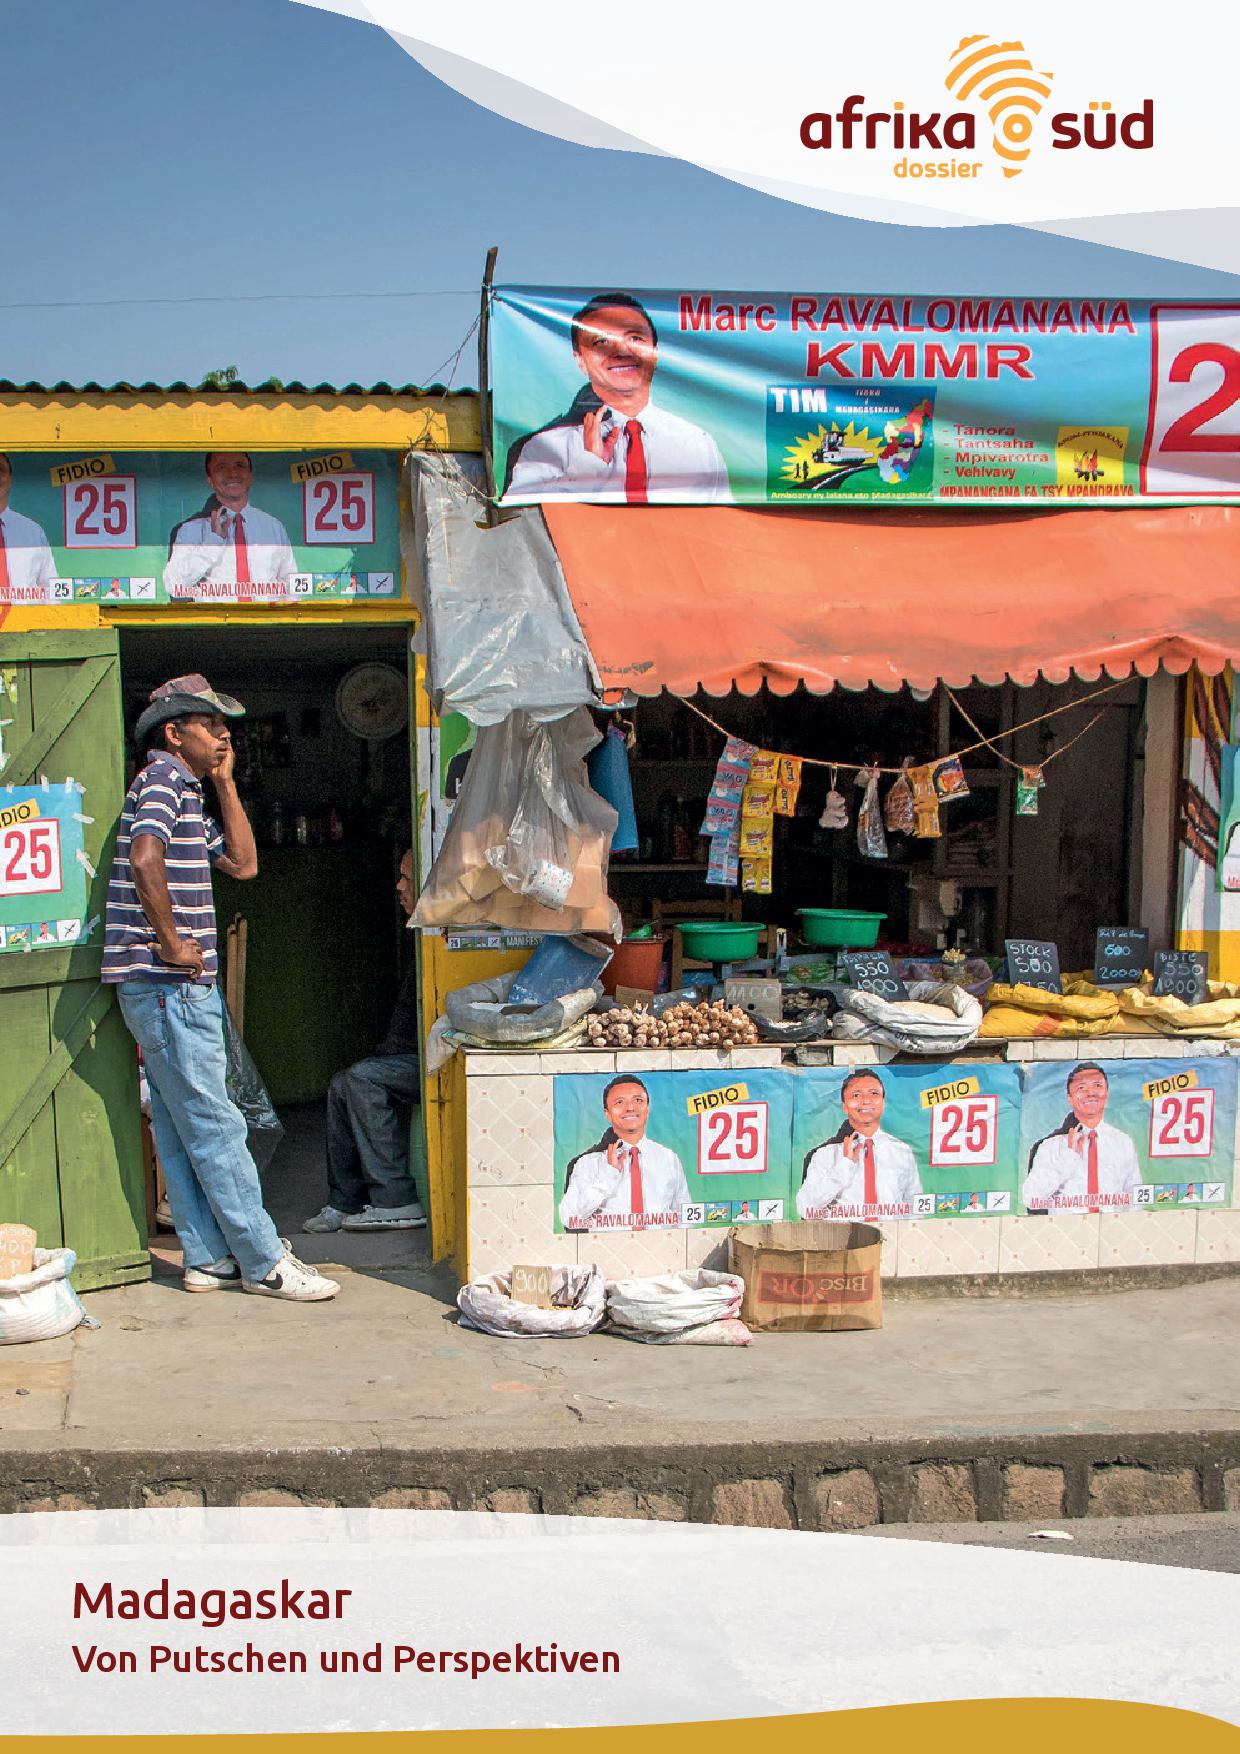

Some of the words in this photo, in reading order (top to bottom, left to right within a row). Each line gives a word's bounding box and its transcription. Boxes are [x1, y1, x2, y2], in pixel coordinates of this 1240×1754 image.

[680, 296, 776, 331] Marc
[791, 297, 1137, 335] RAVALOMANANA
[806, 342, 1035, 380] KMMR
[770, 387, 828, 413] TIM
[1159, 342, 1240, 452] 2
[954, 424, 1016, 436] Tanora
[955, 438, 1034, 449] Tantsaha
[297, 456, 344, 479] FIDIO
[955, 452, 1049, 464] Mpivarotra
[57, 459, 105, 483] FIDIO
[955, 466, 1016, 480] Vehivavy
[74, 483, 128, 535] 25
[313, 480, 367, 532] 25
[55, 583, 70, 598] 25
[200, 582, 288, 597] RAVALOMANANA
[294, 578, 309, 593] 25
[4, 828, 52, 881] 25
[1009, 943, 1051, 958] STOCK
[854, 961, 889, 978] 550
[927, 1081, 970, 1105] FIDIO
[1147, 1074, 1190, 1098] FIDIO
[693, 1088, 739, 1112] FIDIO
[939, 1104, 989, 1153] 25
[1158, 1097, 1205, 1145] 25
[708, 1111, 759, 1160] 25
[918, 1198, 931, 1212] 25
[1054, 1193, 1130, 1209] RAVALOMANANA
[1137, 1189, 1150, 1202] 25
[595, 1212, 679, 1228] RAVALOMANANA
[686, 1207, 701, 1221] 25
[831, 1203, 910, 1219] RAVALOMANANA
[515, 1268, 548, 1293] 900
